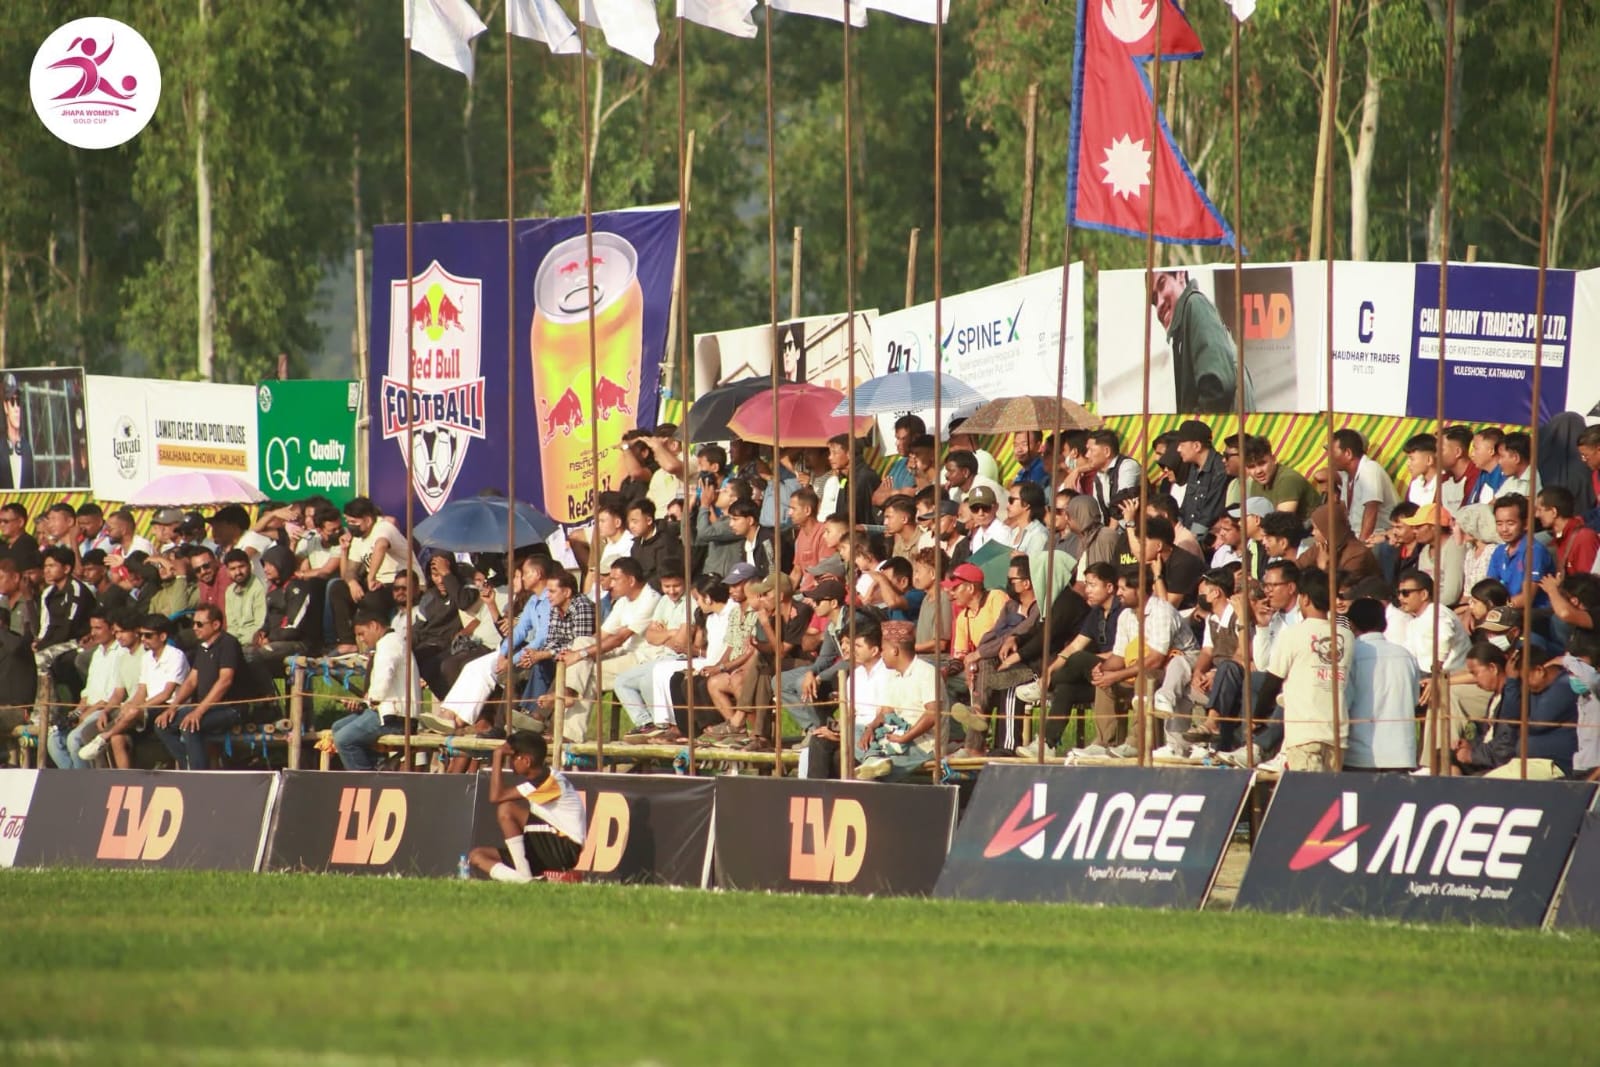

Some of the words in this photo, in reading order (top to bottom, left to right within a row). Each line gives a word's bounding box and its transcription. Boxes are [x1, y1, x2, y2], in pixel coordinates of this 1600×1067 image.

[1420, 308, 1480, 335] CHADHARY
[1481, 311, 1525, 338] TRADERS
[957, 320, 1002, 355] SPINE
[411, 349, 432, 379] Red
[435, 349, 460, 379] Bull
[1332, 350, 1369, 362] HAUDHARY
[1370, 352, 1400, 364] TRADERS
[1488, 367, 1525, 380] KATHMANDU
[385, 385, 481, 431] FOOTBALL
[155, 420, 176, 439] LAWATI
[177, 421, 193, 440] CAFE
[195, 422, 208, 441] AND
[209, 423, 225, 442] POOL
[225, 425, 246, 444] HOUSE
[112, 434, 141, 460] Lawati
[309, 439, 345, 465] Quality
[305, 466, 350, 492] Computer
[1115, 867, 1149, 883] Clothing
[1441, 883, 1480, 900] Clothing
[1480, 885, 1513, 900] Brand
